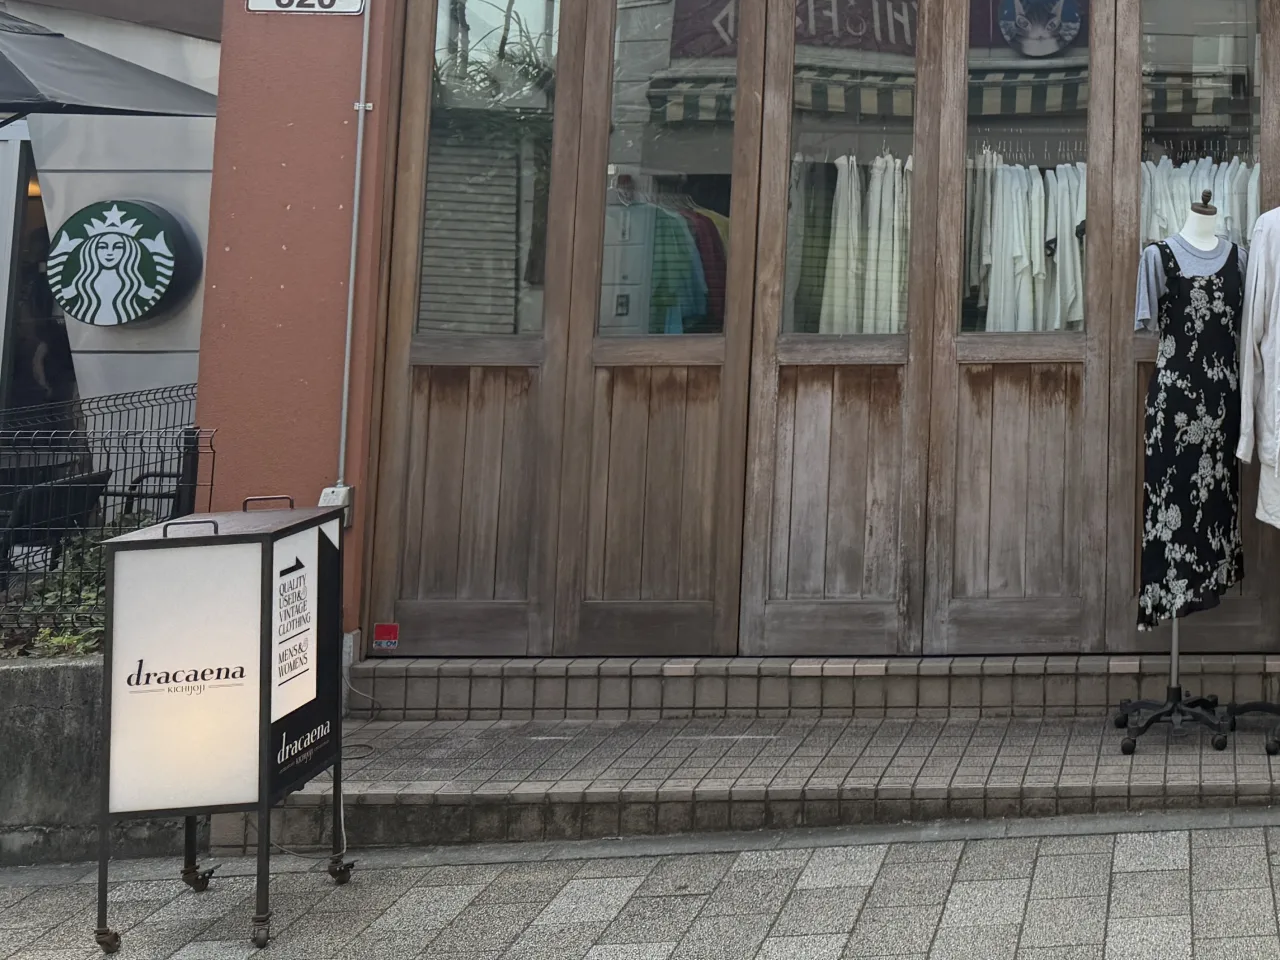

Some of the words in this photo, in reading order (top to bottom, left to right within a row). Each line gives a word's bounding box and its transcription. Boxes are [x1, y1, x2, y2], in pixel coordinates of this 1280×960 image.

[279, 574, 307, 596] QUALITY
[279, 599, 308, 623] VINTAGE
[278, 612, 311, 637] CLOTHING
[126, 659, 246, 687] dracaena
[278, 652, 308, 678] WOMENS
[277, 720, 331, 764] dracaena
